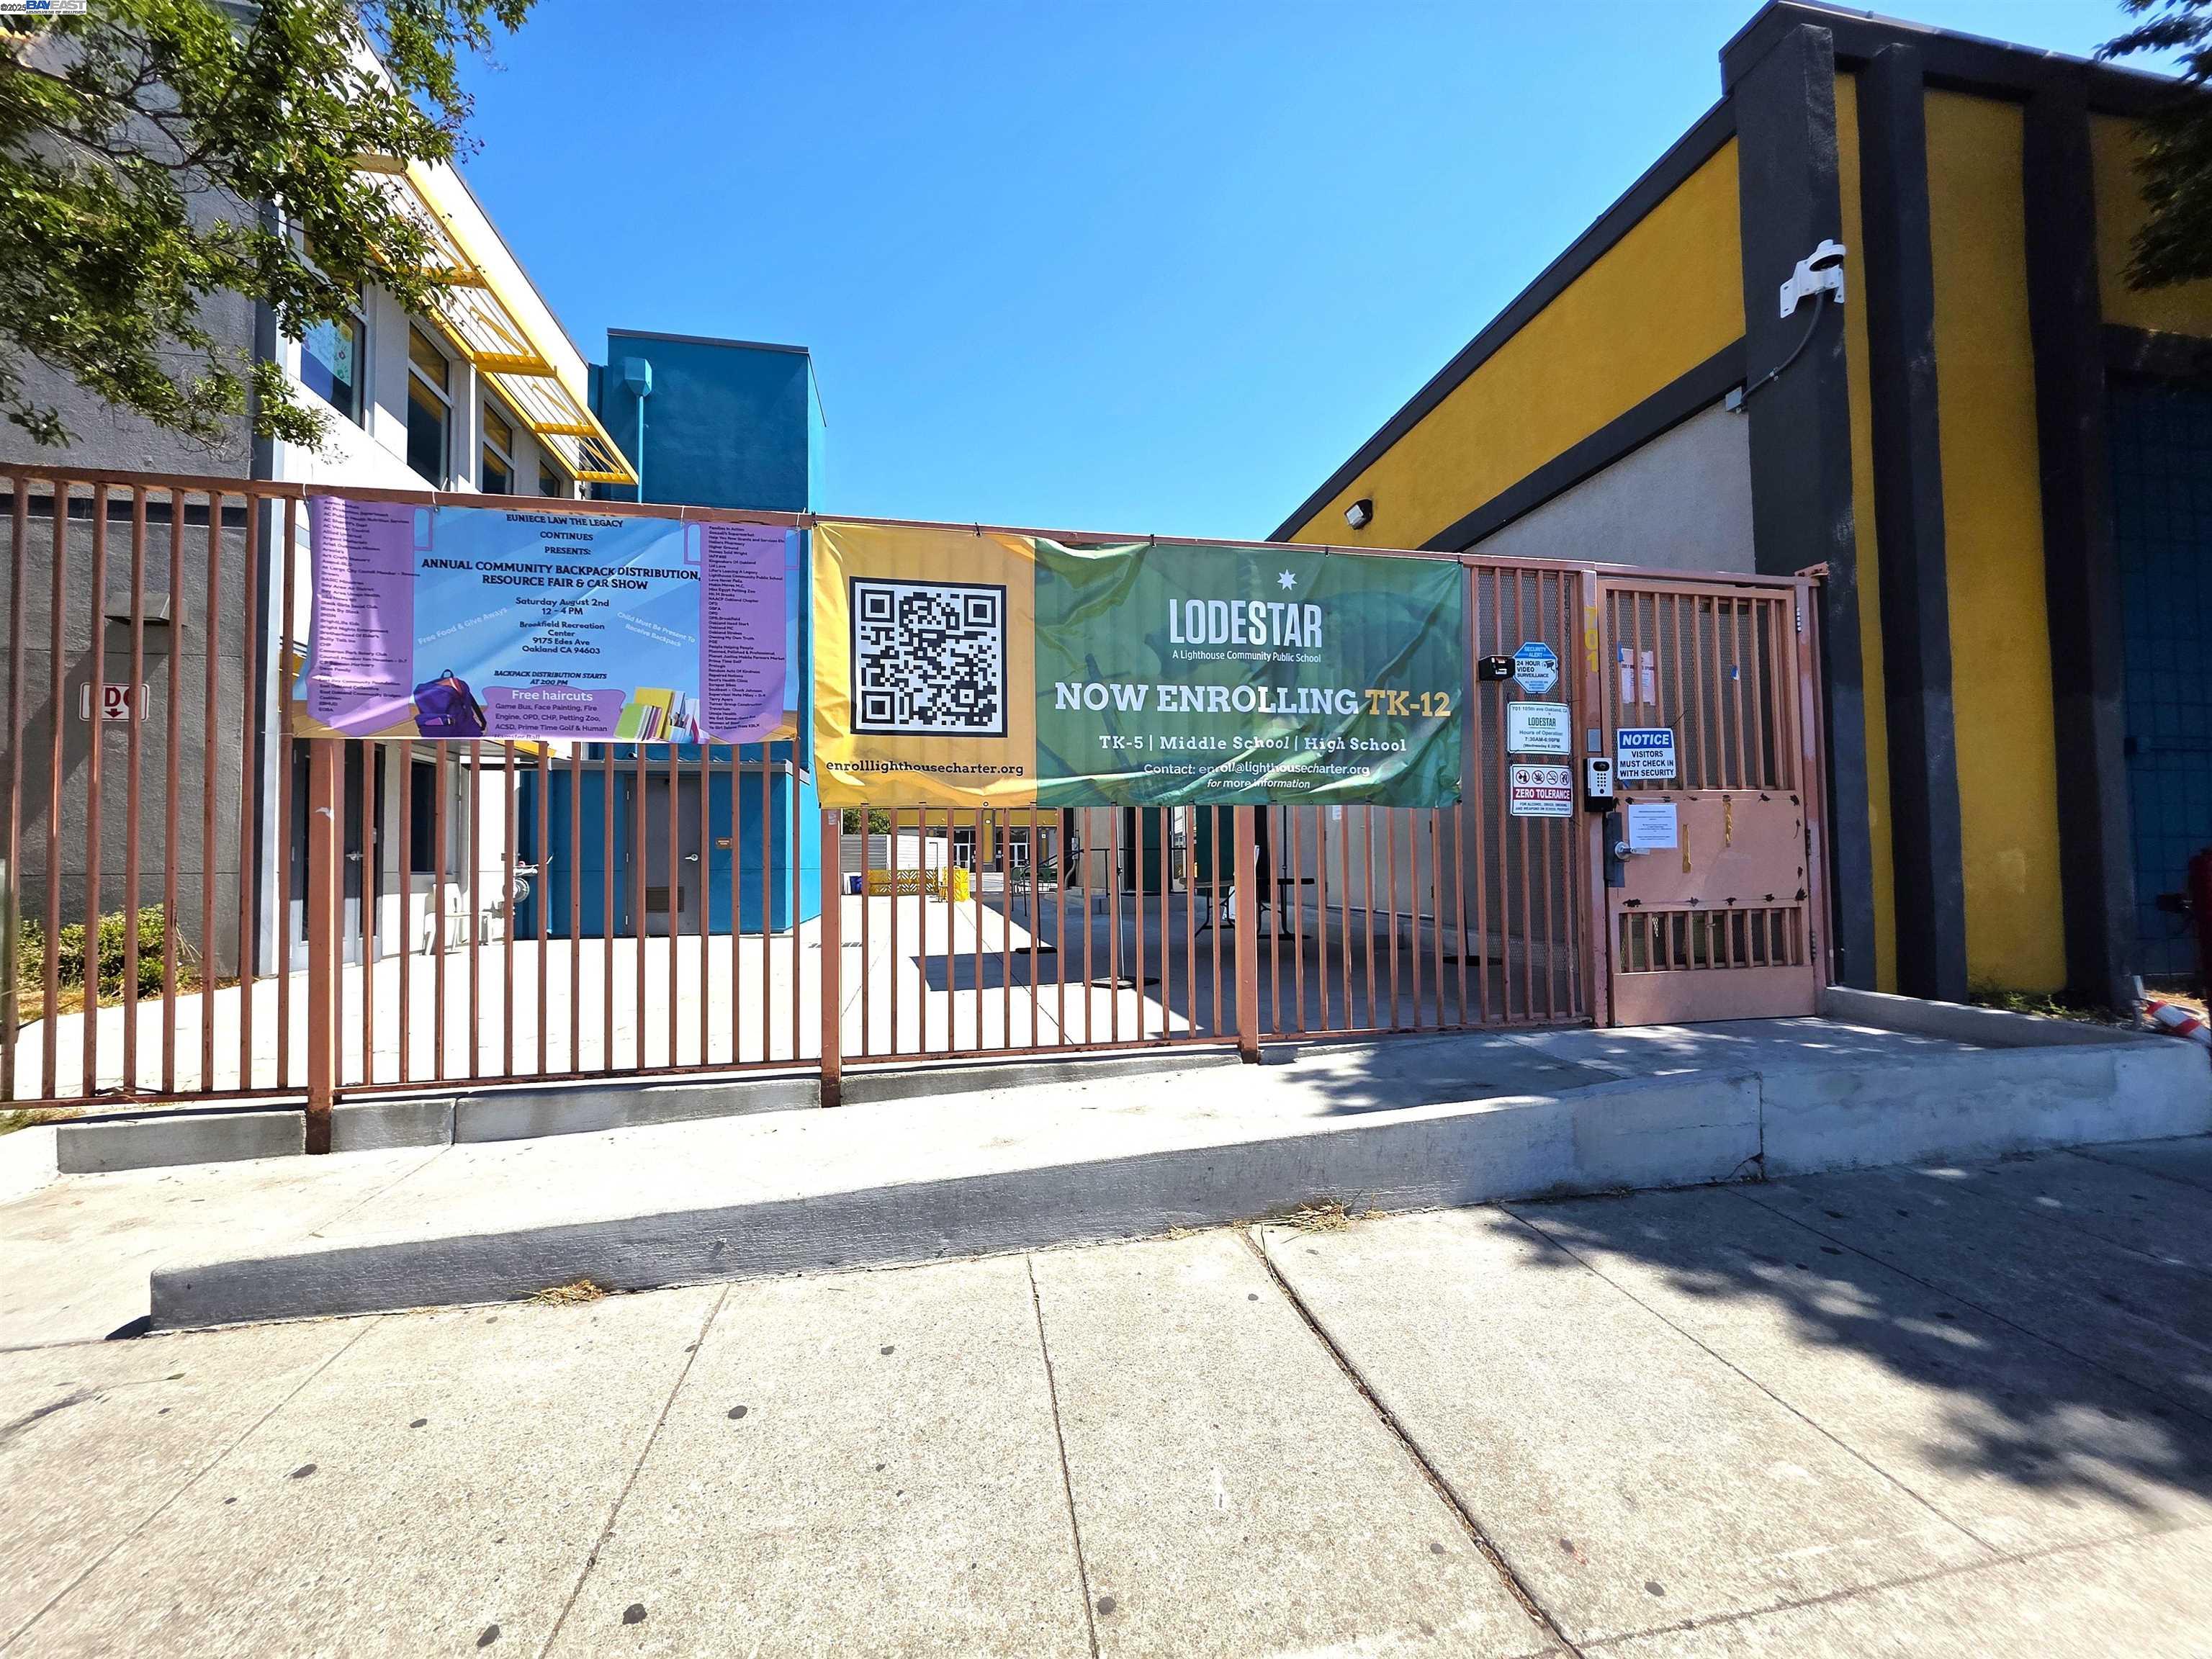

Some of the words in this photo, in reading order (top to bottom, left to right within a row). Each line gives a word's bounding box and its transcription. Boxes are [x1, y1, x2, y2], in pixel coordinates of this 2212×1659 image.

[506, 514, 546, 523] EUNIECE
[570, 518, 588, 526] THE
[589, 519, 623, 528] LEGACY
[540, 531, 593, 541] CONTINUES
[545, 547, 591, 555] PRESENTS:
[422, 559, 473, 570] ANNUAL
[475, 562, 553, 574] COMMUNITY
[556, 565, 616, 576] BACKPACK
[617, 567, 701, 581] DISTRIBUTION,
[482, 575, 544, 586] RESOURCE
[547, 577, 573, 588] FAIR
[576, 579, 585, 588] &
[587, 578, 608, 588] CAR
[611, 580, 649, 590] SHOW
[516, 597, 557, 607] Saturday
[559, 598, 589, 607] August
[591, 598, 609, 607] 2nd
[617, 611, 634, 622] Child
[635, 617, 652, 628] Must
[662, 627, 686, 640] Present
[1169, 598, 1322, 648] LODESTAR
[418, 634, 436, 645] Free
[436, 626, 457, 637] Food
[464, 616, 482, 627] Give
[625, 624, 651, 637] Receive
[651, 633, 680, 647] Backpack
[1172, 649, 1179, 658] A
[1180, 649, 1225, 661] Lighthouse
[1226, 650, 1271, 662] Community
[1272, 652, 1294, 662] Public
[1296, 653, 1321, 662] School
[512, 690, 540, 700] Free
[543, 691, 593, 701] haircuts
[1054, 682, 1149, 711] NOW
[1156, 684, 1359, 715] ENROLLING
[1364, 688, 1452, 717] TK-12
[1528, 717, 1556, 727] LODESTAR
[1099, 735, 1144, 750] TK-5
[1160, 736, 1227, 750] Middle
[1233, 735, 1290, 750] School
[1304, 737, 1345, 753] High
[1349, 737, 1407, 752] School
[1622, 734, 1669, 745] NOTICE
[826, 760, 1024, 776] enrolllighthousecharter.org
[1143, 763, 1196, 775] Contact:
[1199, 762, 1370, 776] enroll@lighthousecharter.org
[1207, 778, 1221, 788] for
[1253, 778, 1310, 789] information
[1515, 788, 1534, 799] ZERO
[1535, 789, 1570, 799] TOLERANCE
